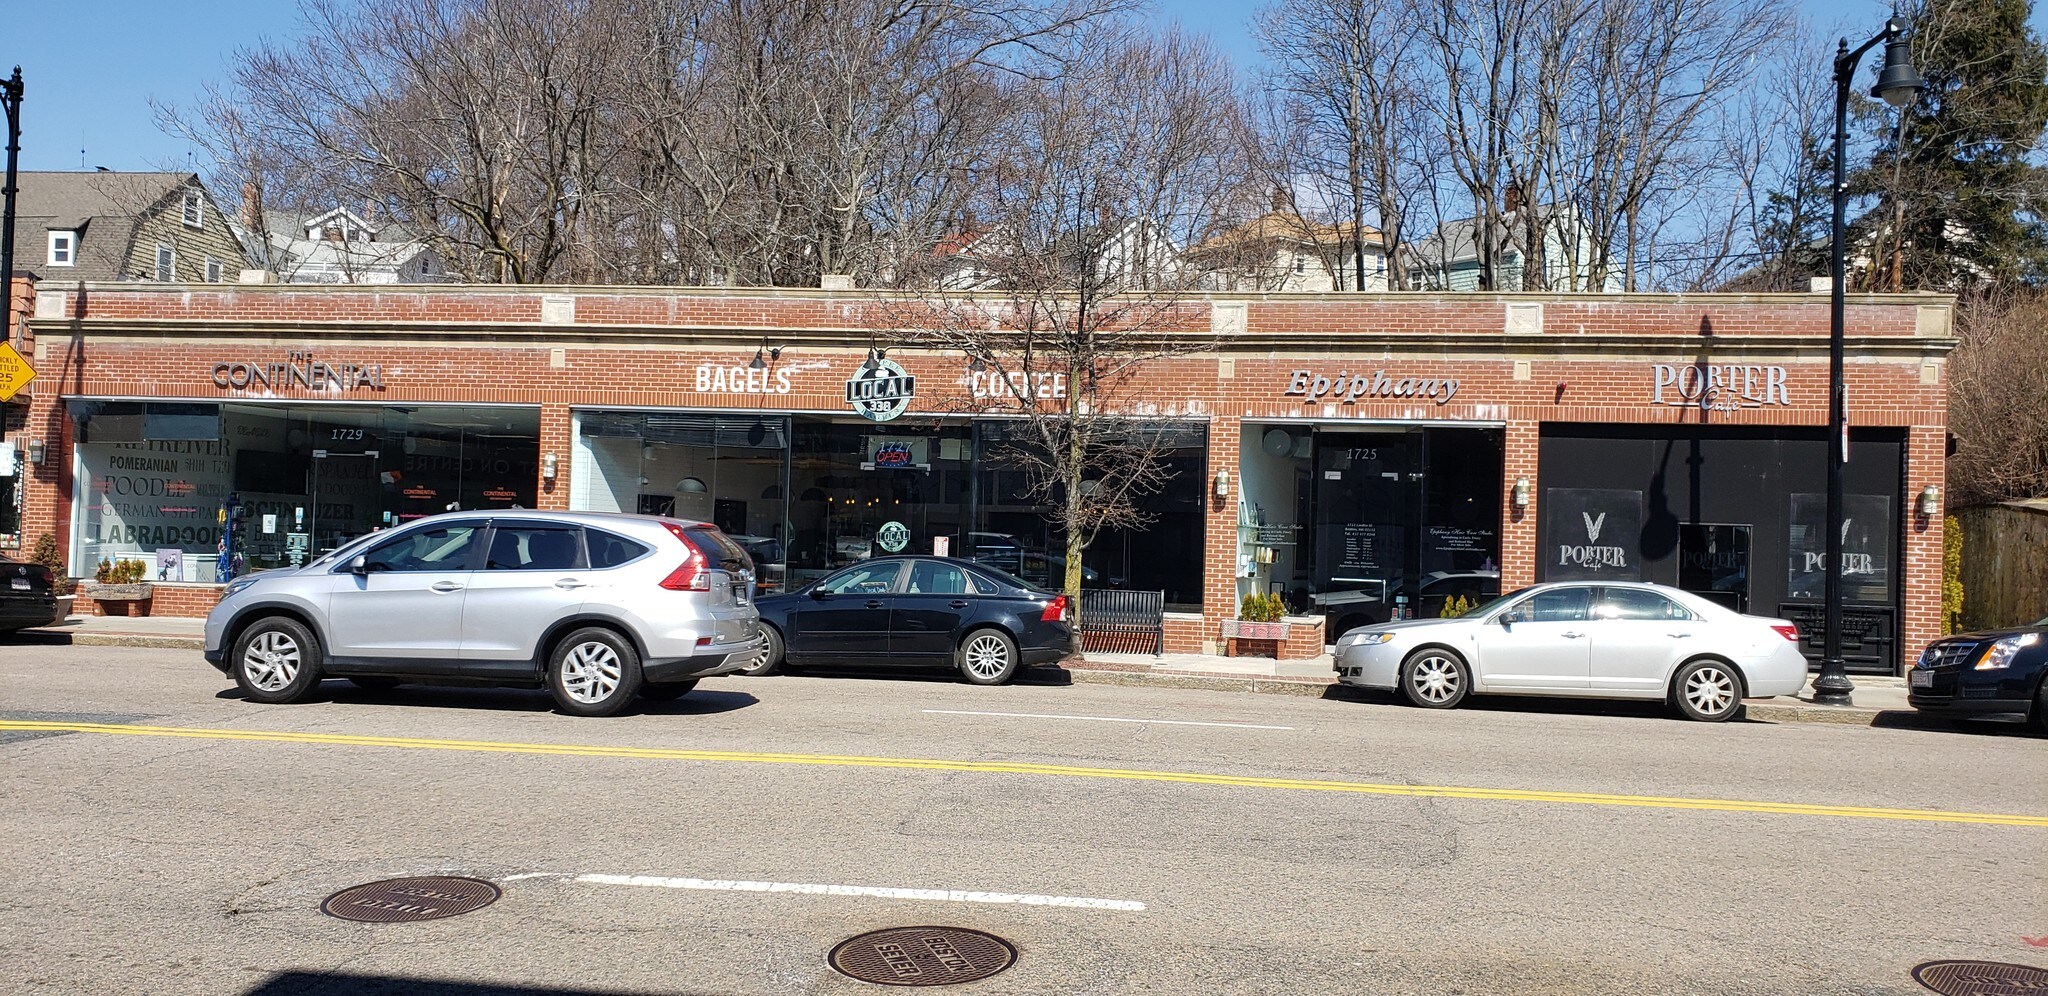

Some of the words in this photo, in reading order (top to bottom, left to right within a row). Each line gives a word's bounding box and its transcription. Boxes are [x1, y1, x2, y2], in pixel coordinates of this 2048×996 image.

[287, 350, 313, 363] THE
[211, 361, 386, 392] CONTINENTAL
[695, 366, 792, 394] BAGELS
[971, 371, 1067, 398] COFFEE
[1284, 369, 1461, 406] Epiphany
[1650, 364, 1792, 405] PORTER
[850, 377, 911, 400] LOCAL
[869, 401, 891, 412] 338
[331, 428, 363, 440] 1729
[876, 452, 909, 462] OPEN
[879, 441, 913, 453] 1727
[1346, 448, 1377, 460] 1725
[110, 455, 178, 473] POMERANIAN
[103, 475, 186, 498] POODLE
[101, 502, 167, 518] GERMAN
[880, 531, 908, 541] LOCAL
[1559, 545, 1627, 567] PORTER
[1803, 552, 1875, 574] POTER
[876, 943, 921, 976] SEWER
[924, 937, 972, 972] BOSTON
